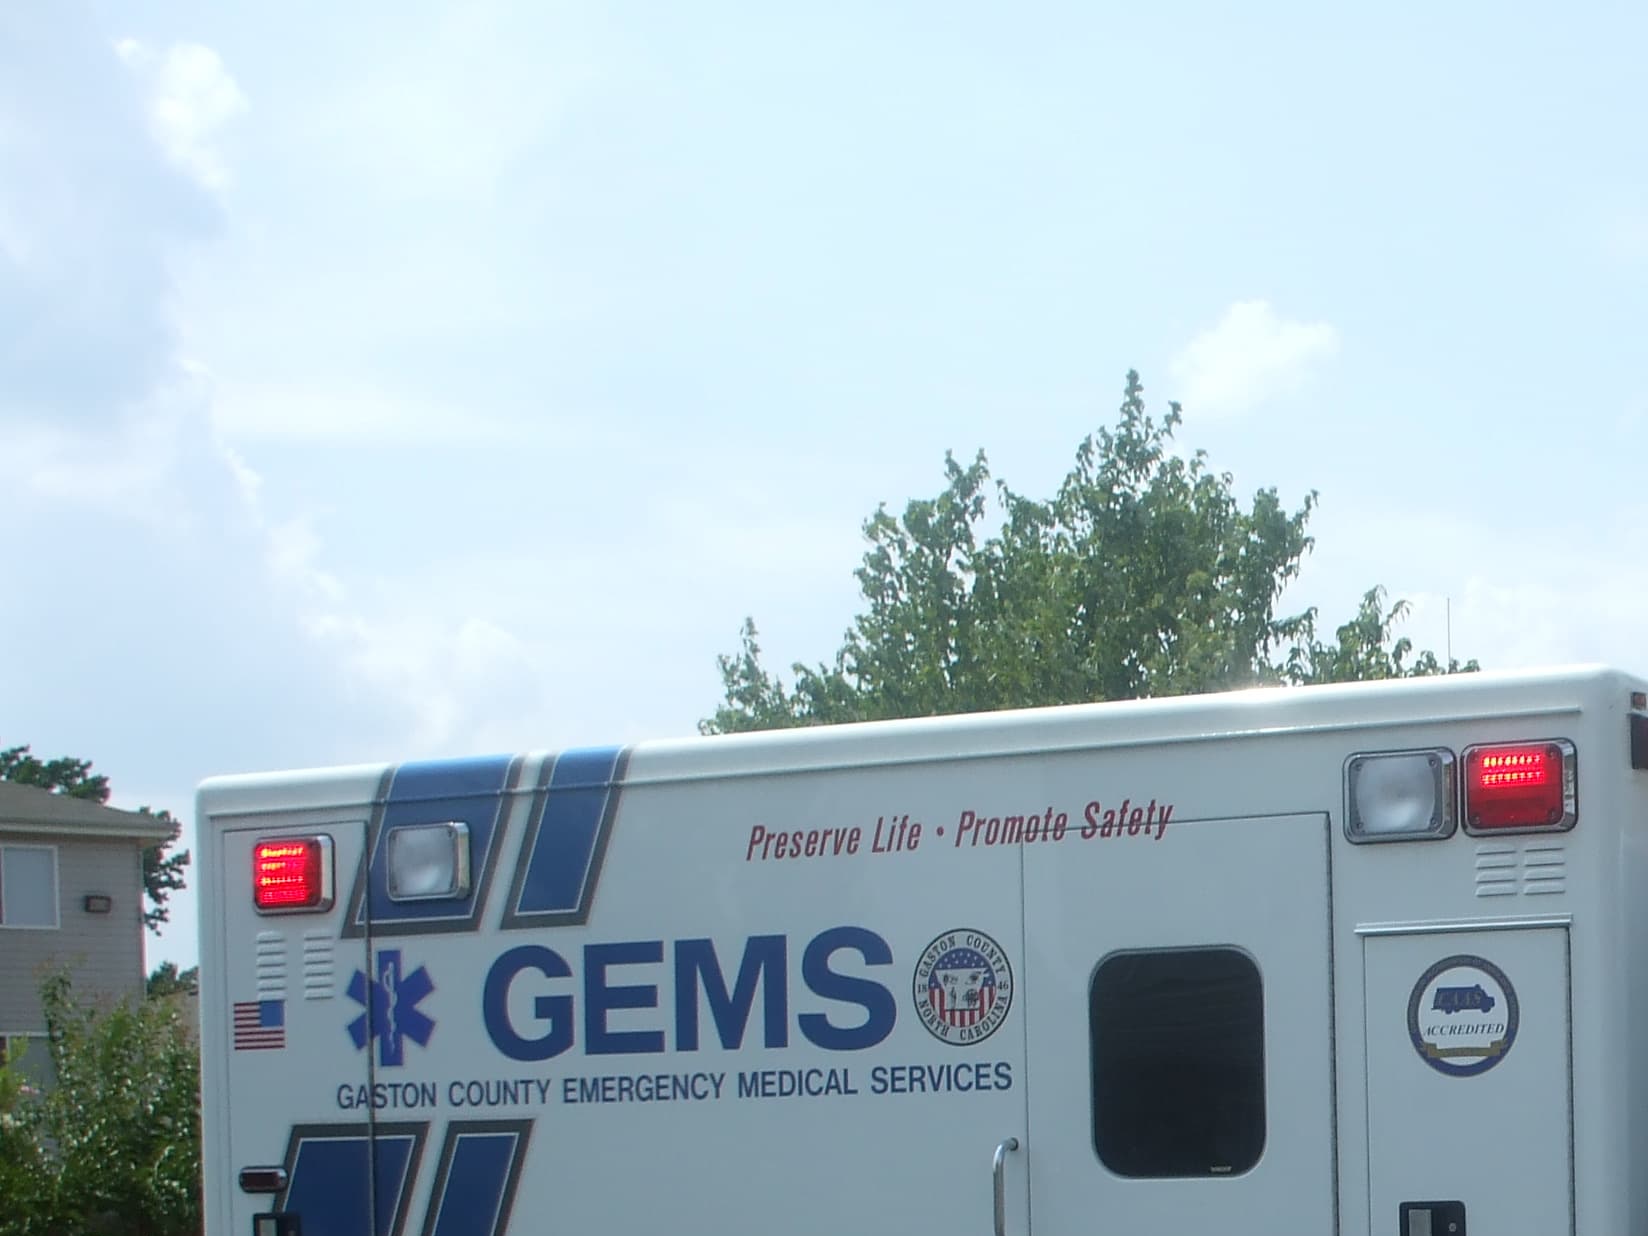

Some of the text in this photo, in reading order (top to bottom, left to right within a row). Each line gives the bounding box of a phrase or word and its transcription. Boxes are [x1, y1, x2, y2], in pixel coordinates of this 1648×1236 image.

[746, 799, 1173, 861] Preserve Life Promote Safety
[919, 935, 1007, 977] GASTON COUNTY
[482, 925, 897, 1062] GEMS
[918, 995, 1008, 1041] NORTH CAROLINA
[1424, 1023, 1505, 1037] ACCREDITED
[337, 1062, 1012, 1109] GASTON COUNTY EMERGENCY MEDICAL SERVICES
